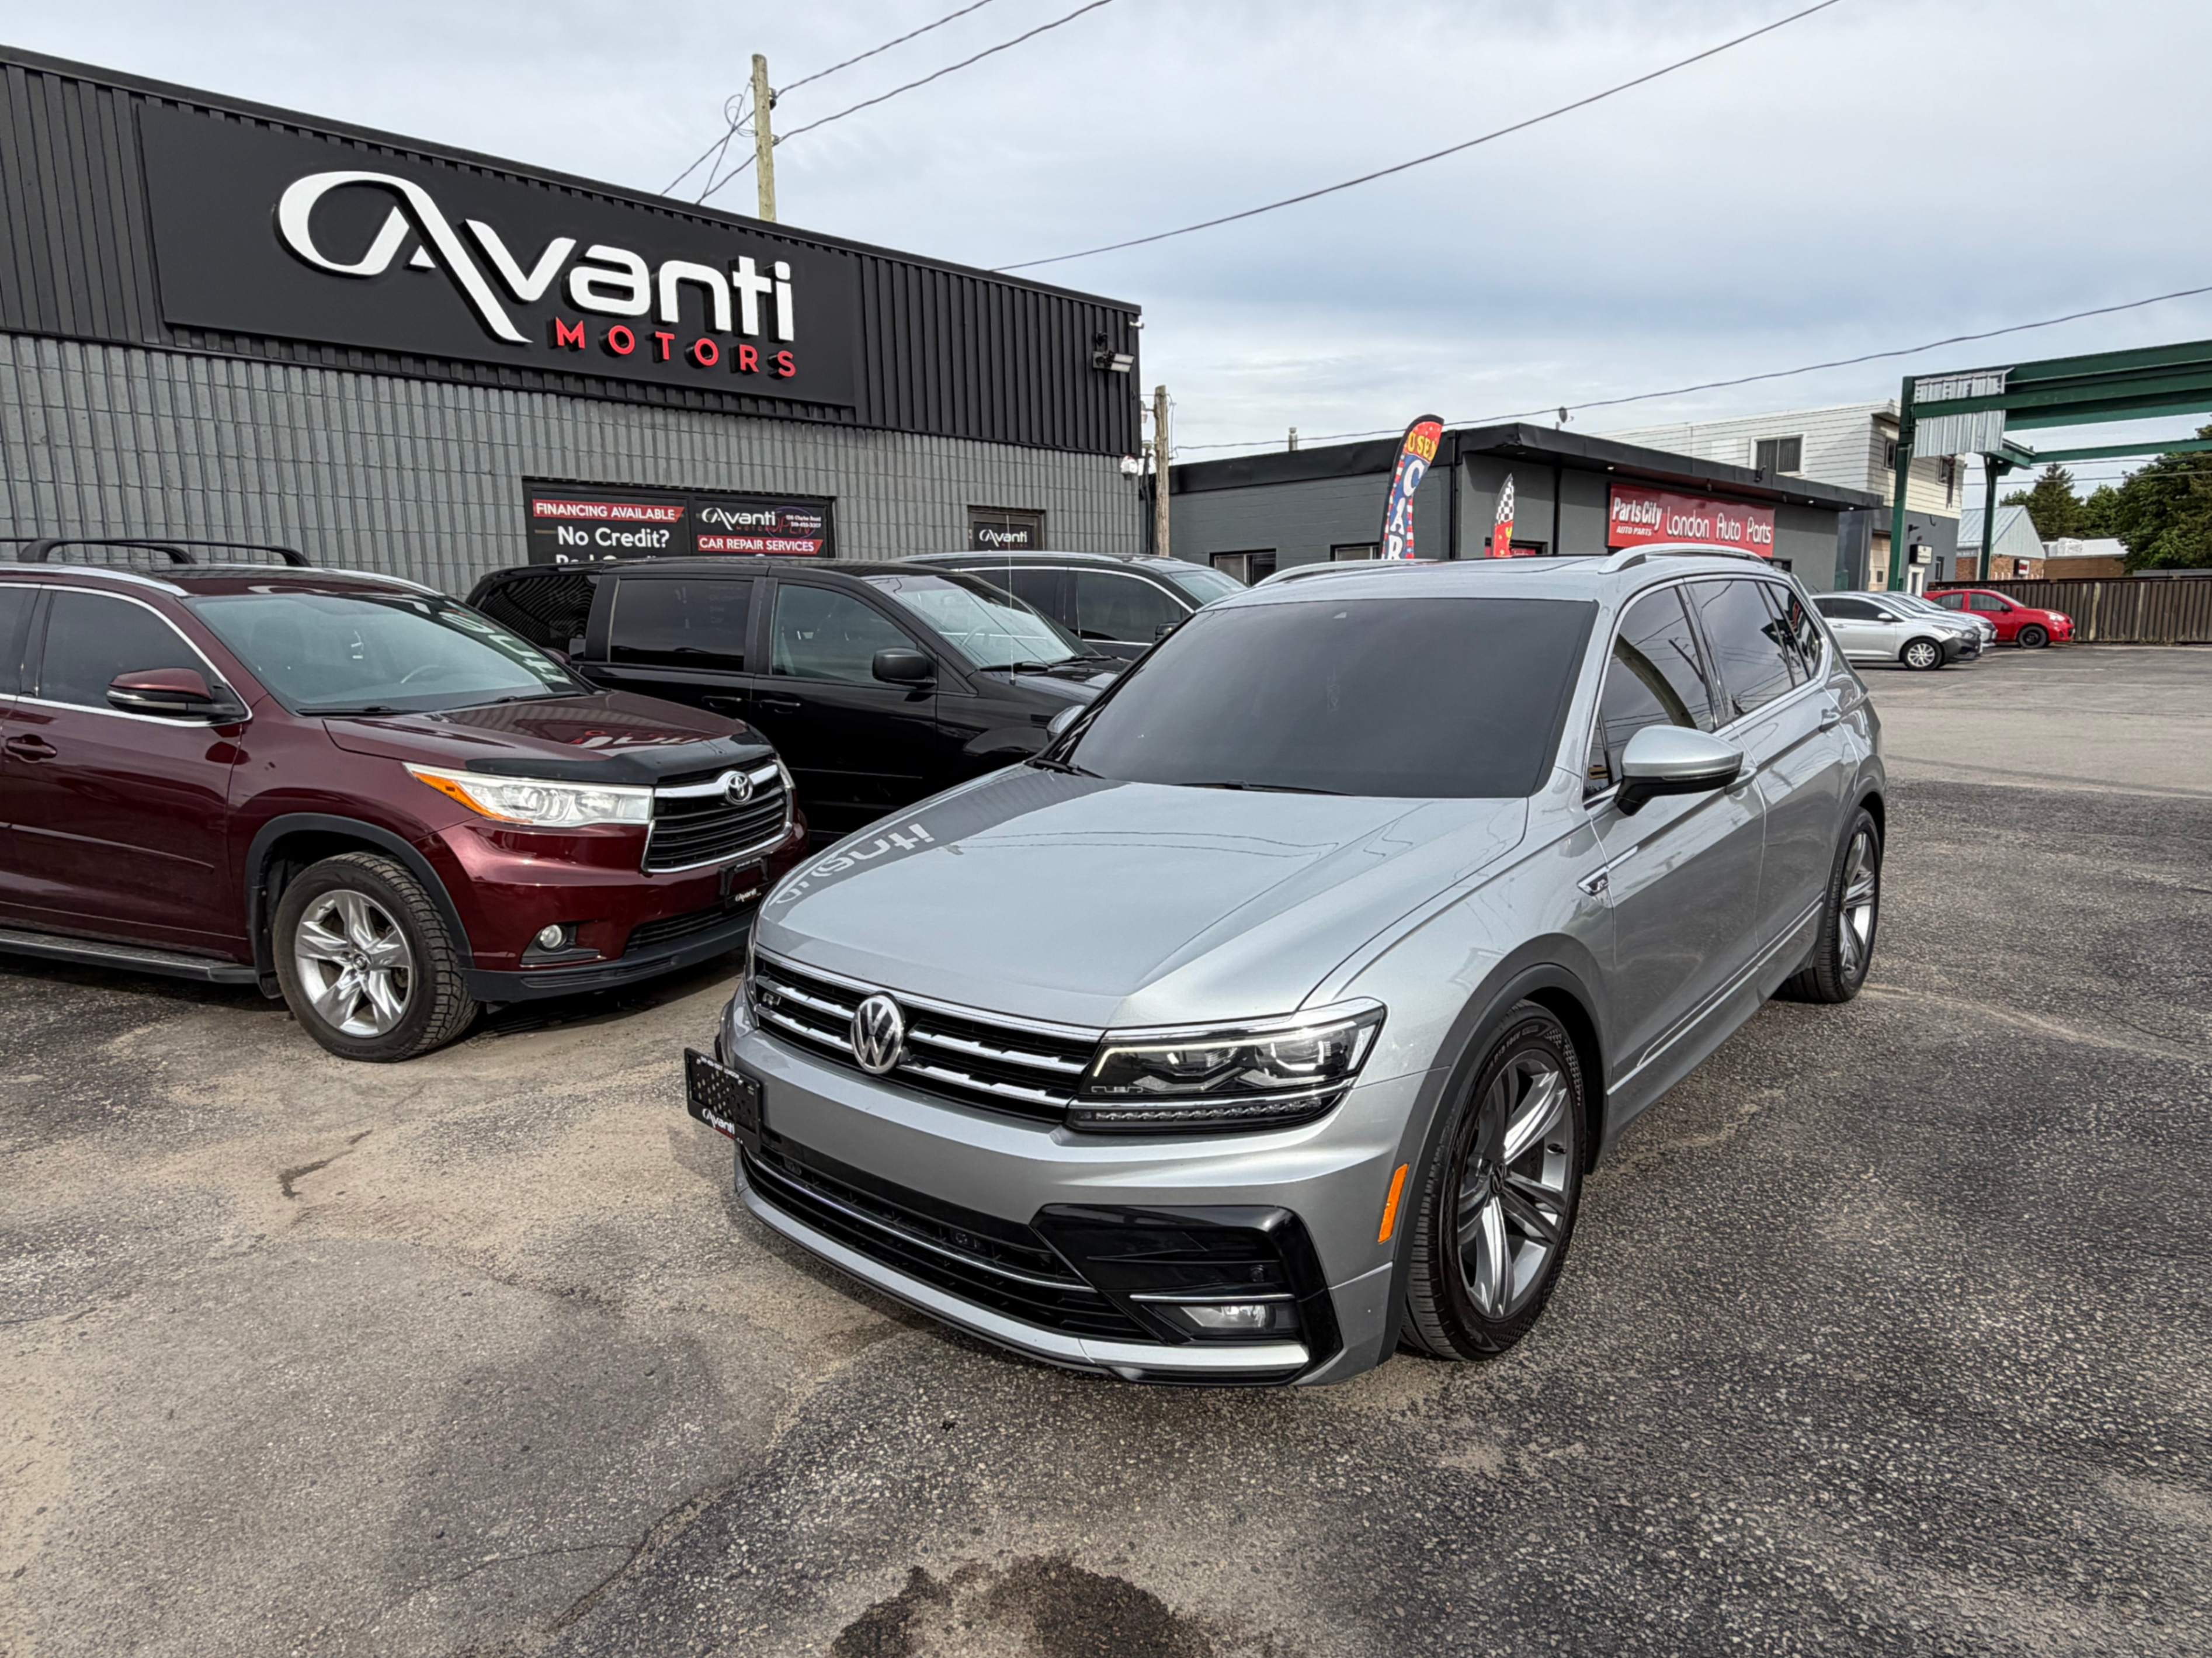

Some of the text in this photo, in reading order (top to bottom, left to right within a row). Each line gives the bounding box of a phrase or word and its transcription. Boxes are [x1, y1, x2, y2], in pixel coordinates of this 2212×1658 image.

[279, 171, 794, 344] Avanti
[555, 316, 797, 379] MOTORS
[536, 502, 675, 520] FINANCING AVAILABLE
[702, 507, 776, 531] Avanti
[1616, 525, 1652, 536] AUTO PARTS
[1666, 506, 1772, 544] London Auto Parts
[557, 526, 670, 547] No Credit?
[699, 537, 814, 551] CAR REPAIR SERVICES
[979, 529, 1027, 547] Avanti
